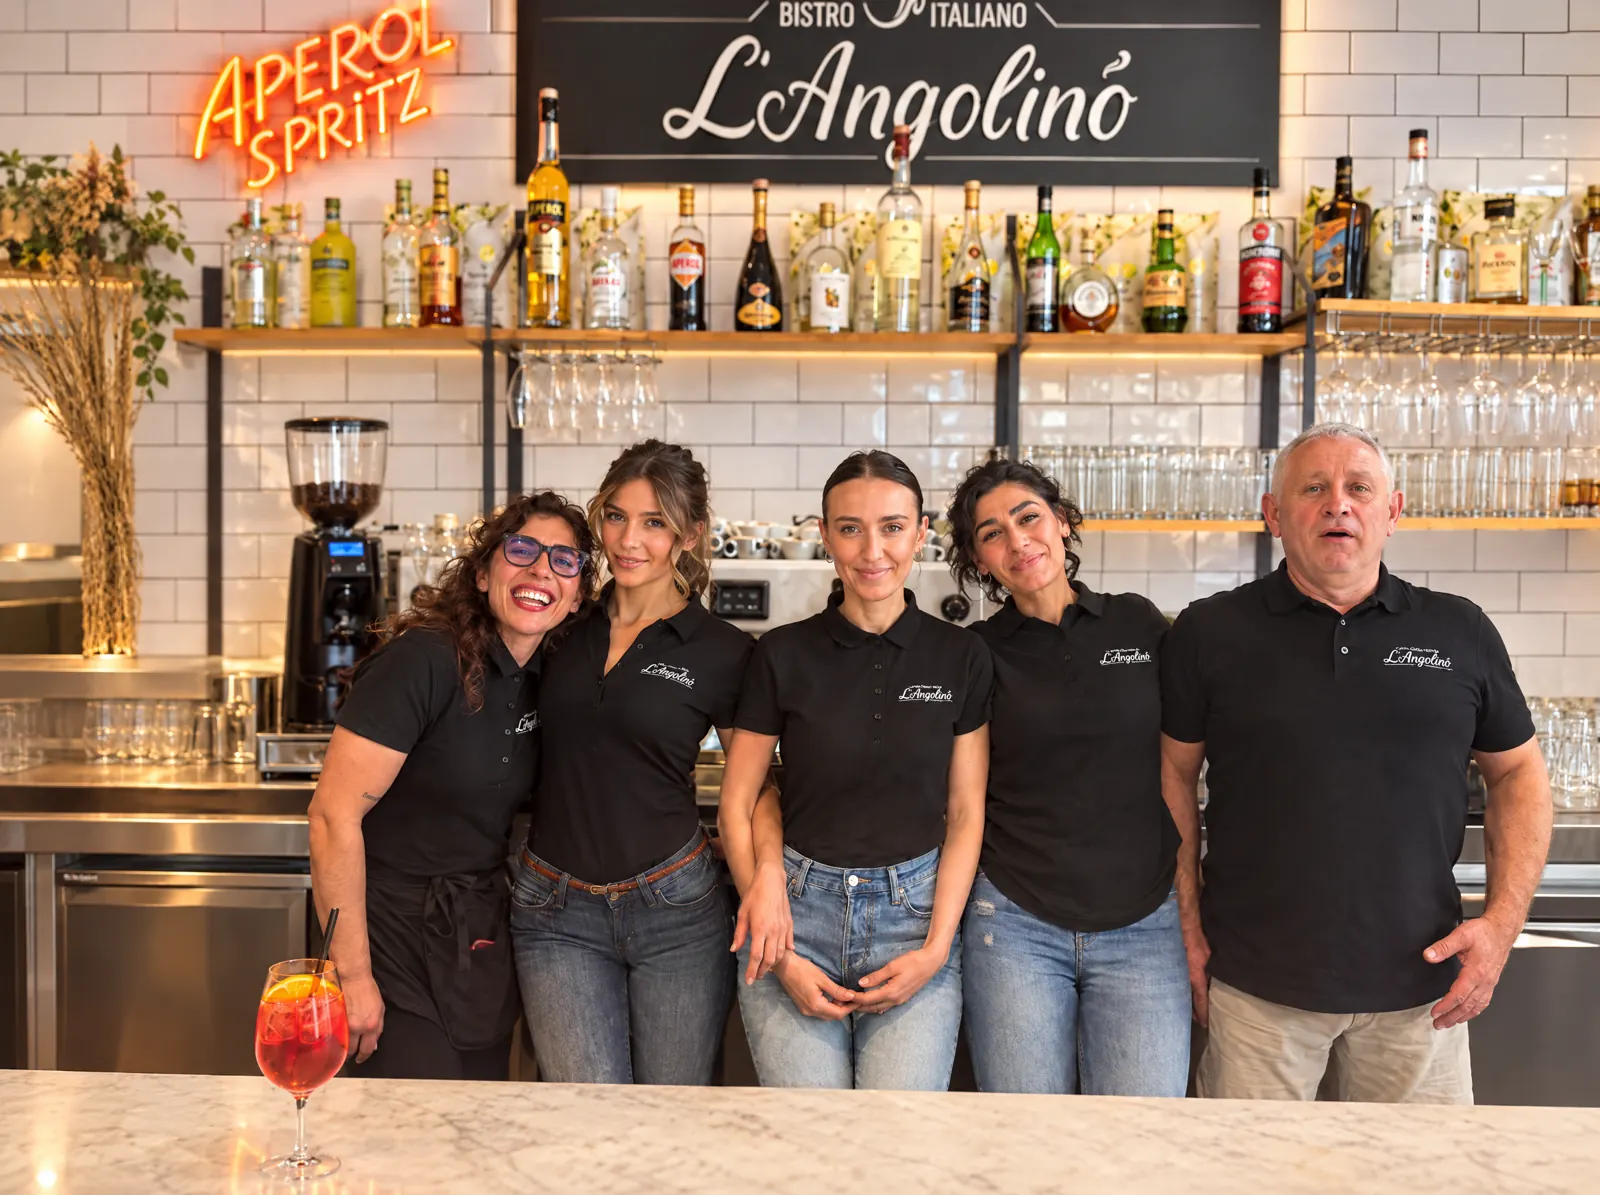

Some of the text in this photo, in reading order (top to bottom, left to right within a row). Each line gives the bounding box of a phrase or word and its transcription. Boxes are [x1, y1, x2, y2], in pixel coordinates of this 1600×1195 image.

[779, 1, 1027, 29] BISTRO ITALIANO
[194, 0, 453, 160] APEROL
